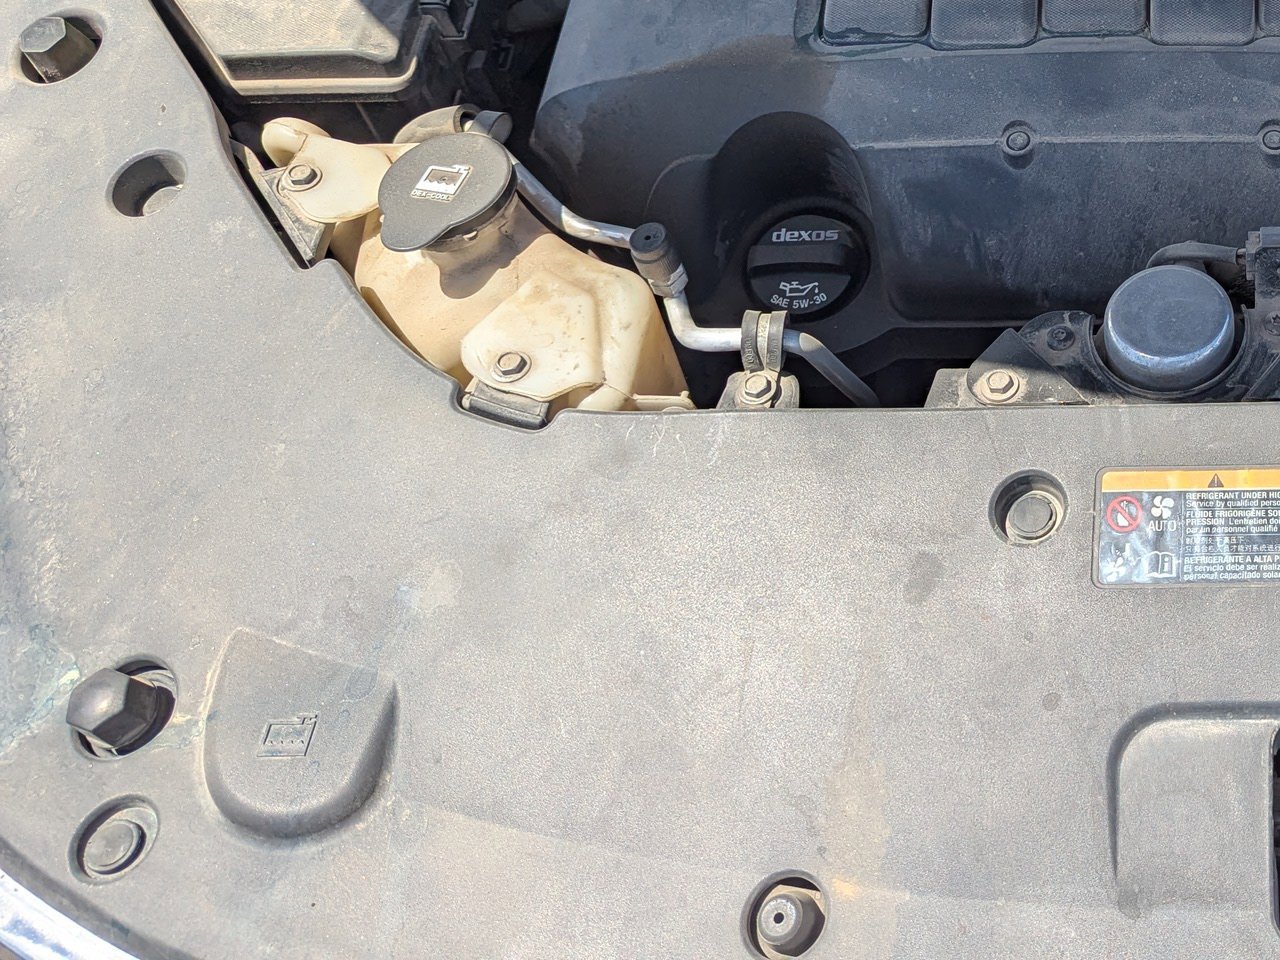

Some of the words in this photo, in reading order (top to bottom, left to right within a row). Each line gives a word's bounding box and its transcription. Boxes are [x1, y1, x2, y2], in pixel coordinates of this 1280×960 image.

[772, 228, 840, 242] dexos
[770, 294, 790, 309] SAE
[792, 292, 828, 309] 5W-30
[1186, 492, 1239, 500] REFRIGERANT
[1186, 500, 1214, 508] Service
[1216, 500, 1225, 508] by
[1227, 500, 1259, 508] qualified
[1186, 510, 1213, 518] FLUIDE
[1215, 508, 1266, 517] FRIGORIGÈNE
[1148, 520, 1177, 532] AUTO
[1186, 527, 1199, 535] par
[1212, 526, 1249, 534] personnel
[1250, 525, 1277, 534] qualifié
[1184, 555, 1244, 564] REFRIGERANTE
[1246, 555, 1252, 563] A
[1254, 555, 1273, 563] ALTA
[1194, 564, 1224, 572] servicio
[1184, 572, 1218, 581] personal
[1219, 571, 1261, 580] capacitado
